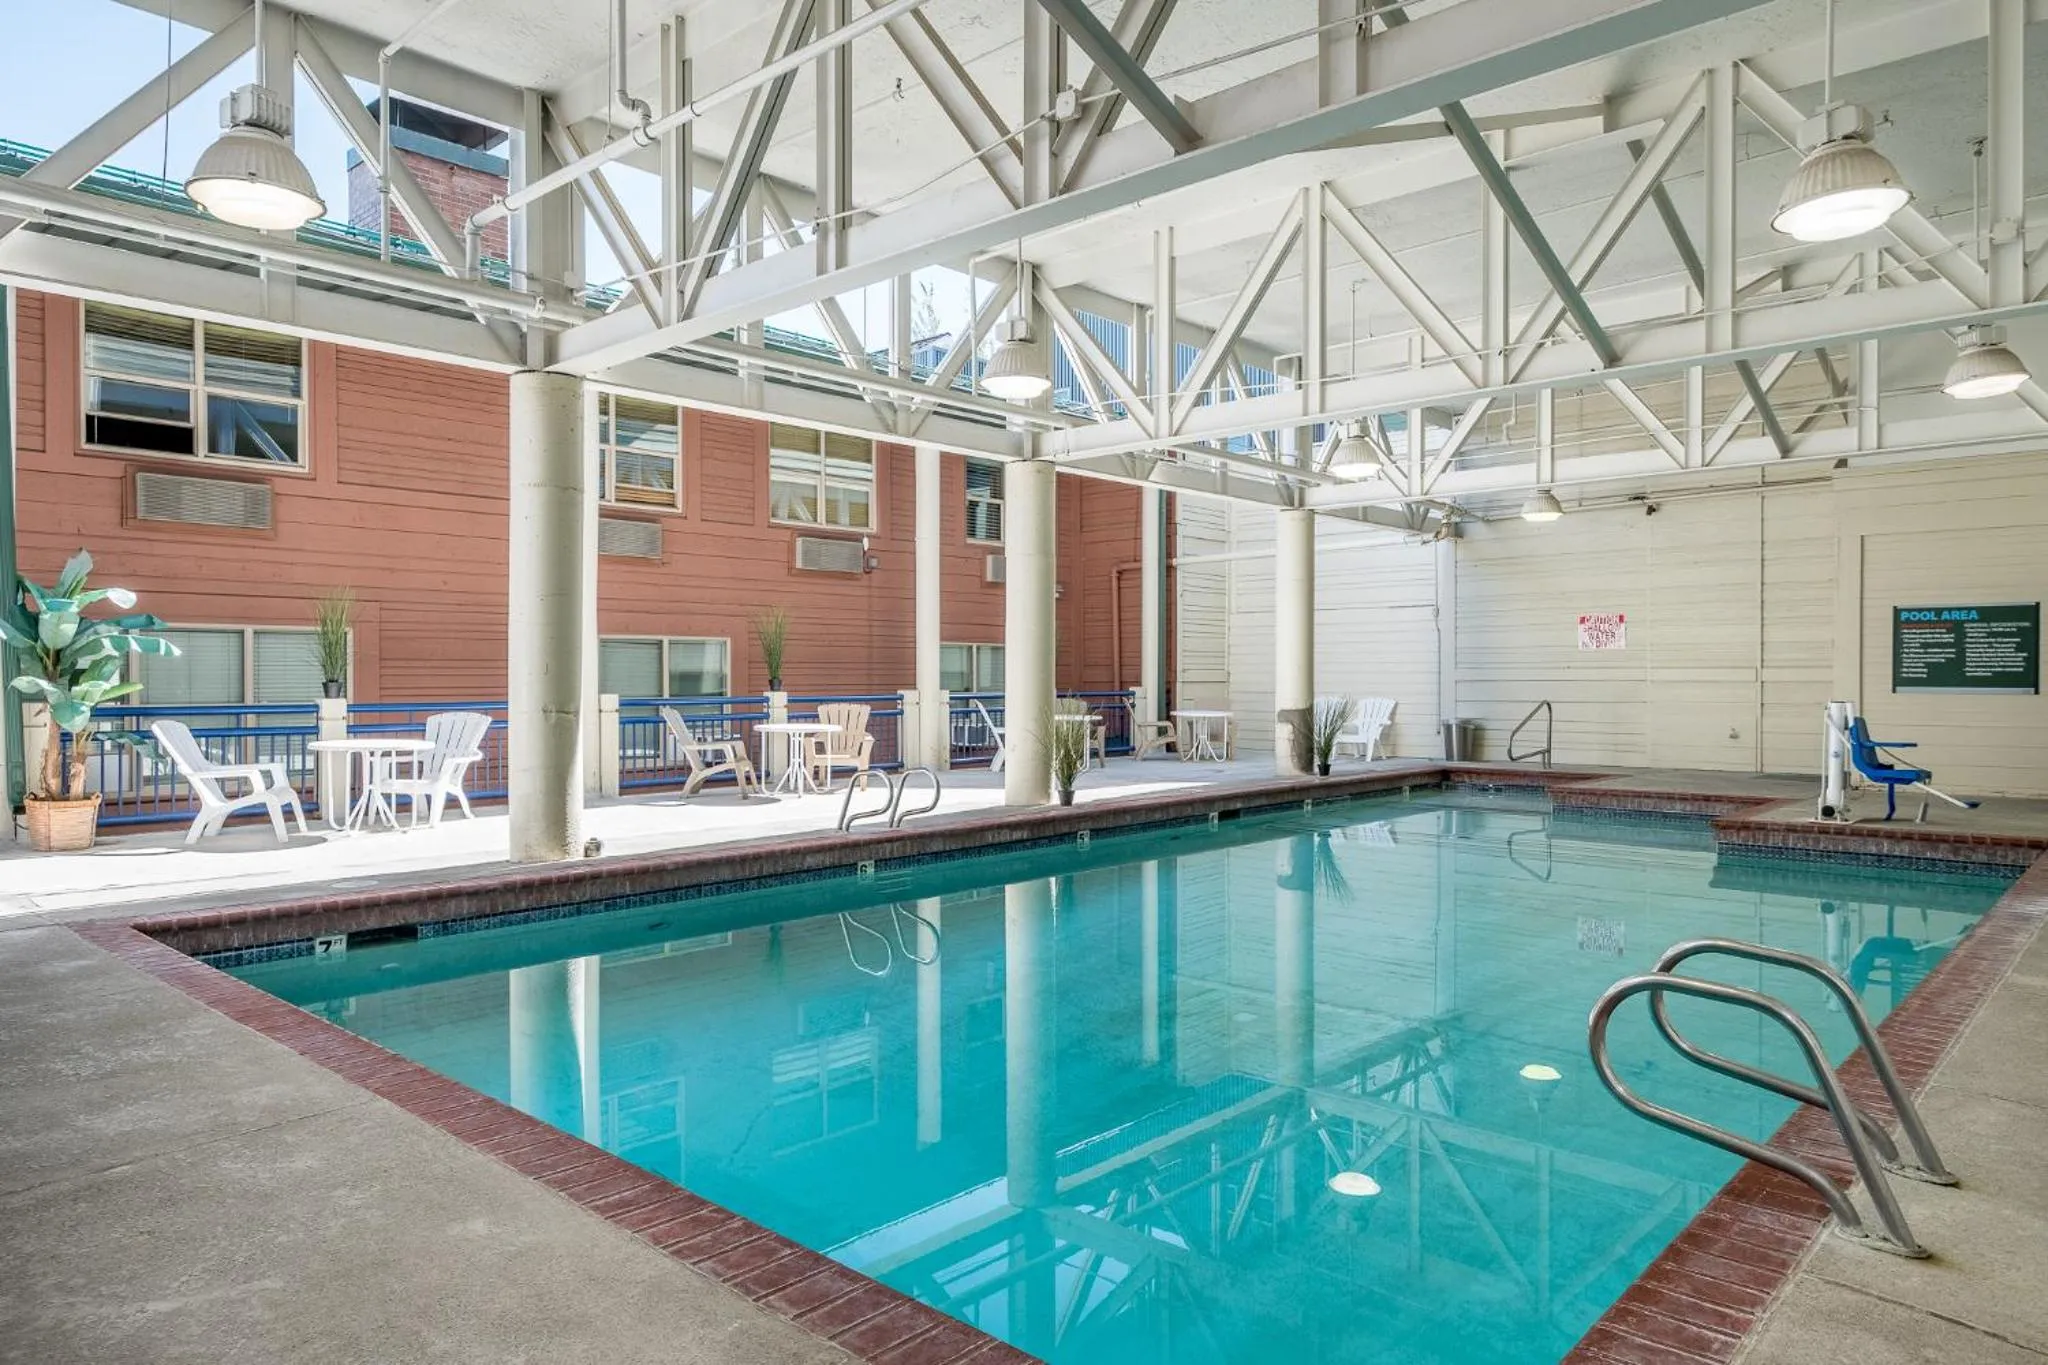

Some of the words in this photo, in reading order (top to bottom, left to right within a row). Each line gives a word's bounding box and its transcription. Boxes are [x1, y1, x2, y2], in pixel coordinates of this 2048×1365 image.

[1900, 611, 1937, 621] POOL
[1941, 609, 1978, 620] AREA
[1588, 631, 1616, 640] WATER
[860, 864, 868, 873] 6
[319, 940, 333, 953] 7
